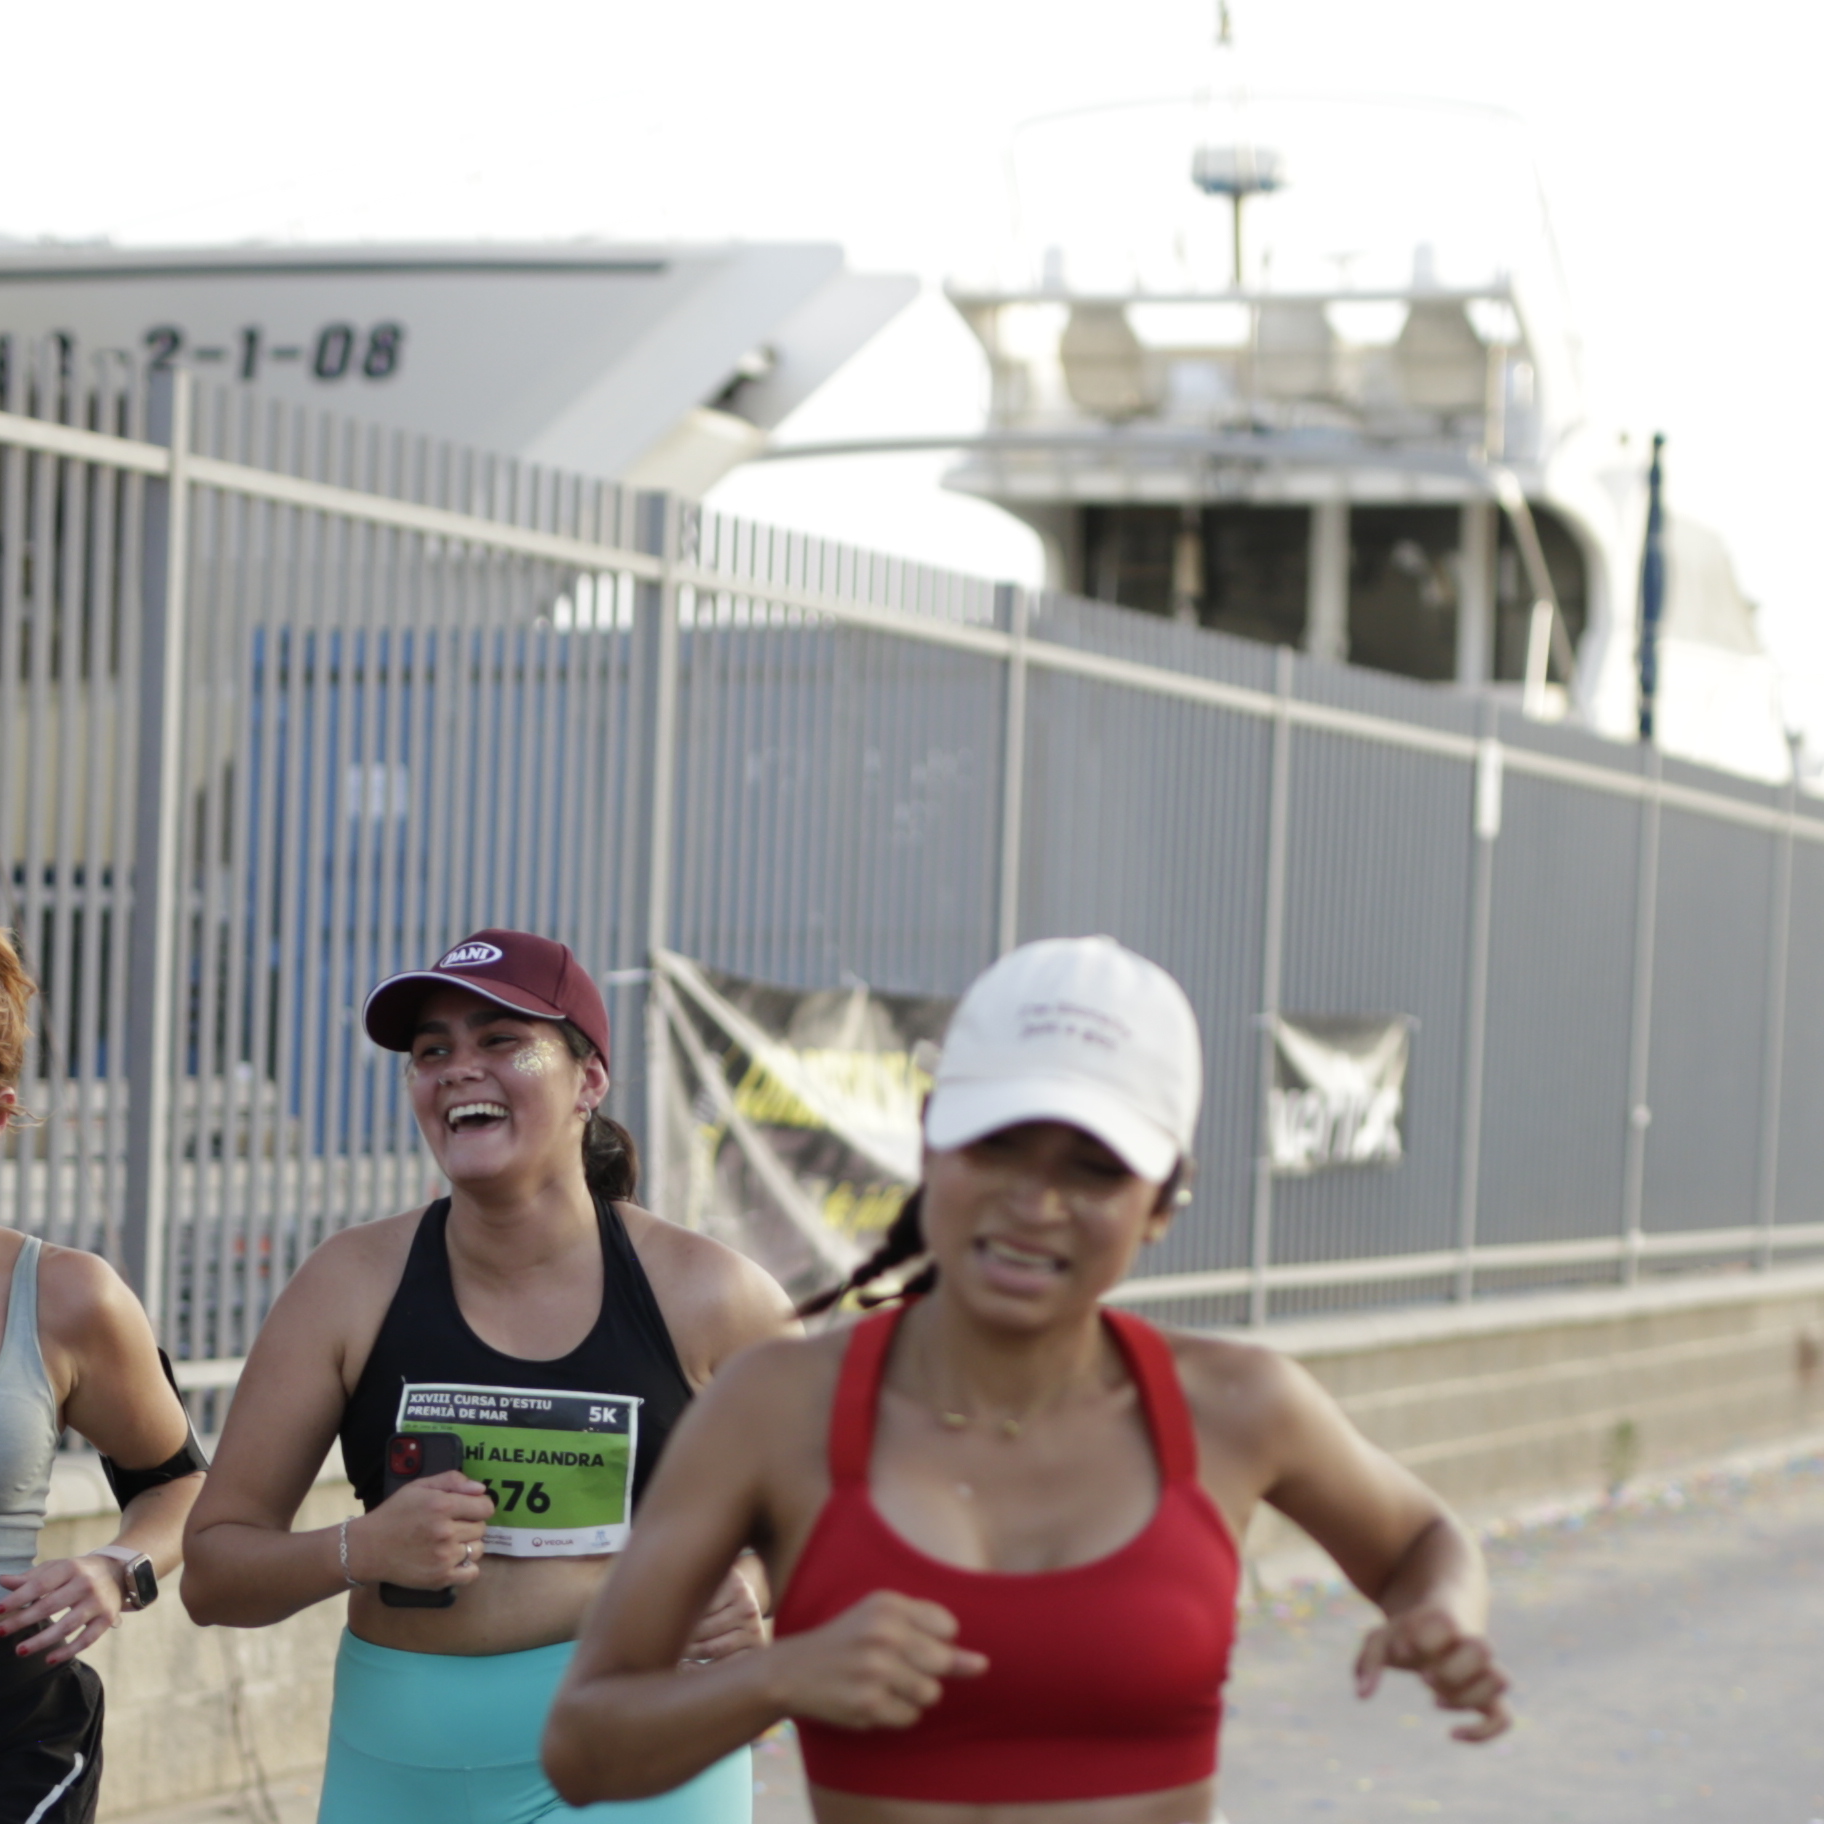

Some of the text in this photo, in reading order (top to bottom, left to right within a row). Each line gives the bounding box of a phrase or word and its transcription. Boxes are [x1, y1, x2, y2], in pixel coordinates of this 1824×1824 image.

[409, 1393, 552, 1410] XXVIII CURSA D'ESTIU
[407, 1404, 509, 1421] PREMIÀ DE MAR
[588, 1406, 617, 1423] 5K
[463, 1441, 605, 1467] HÍ ALEJANDRA
